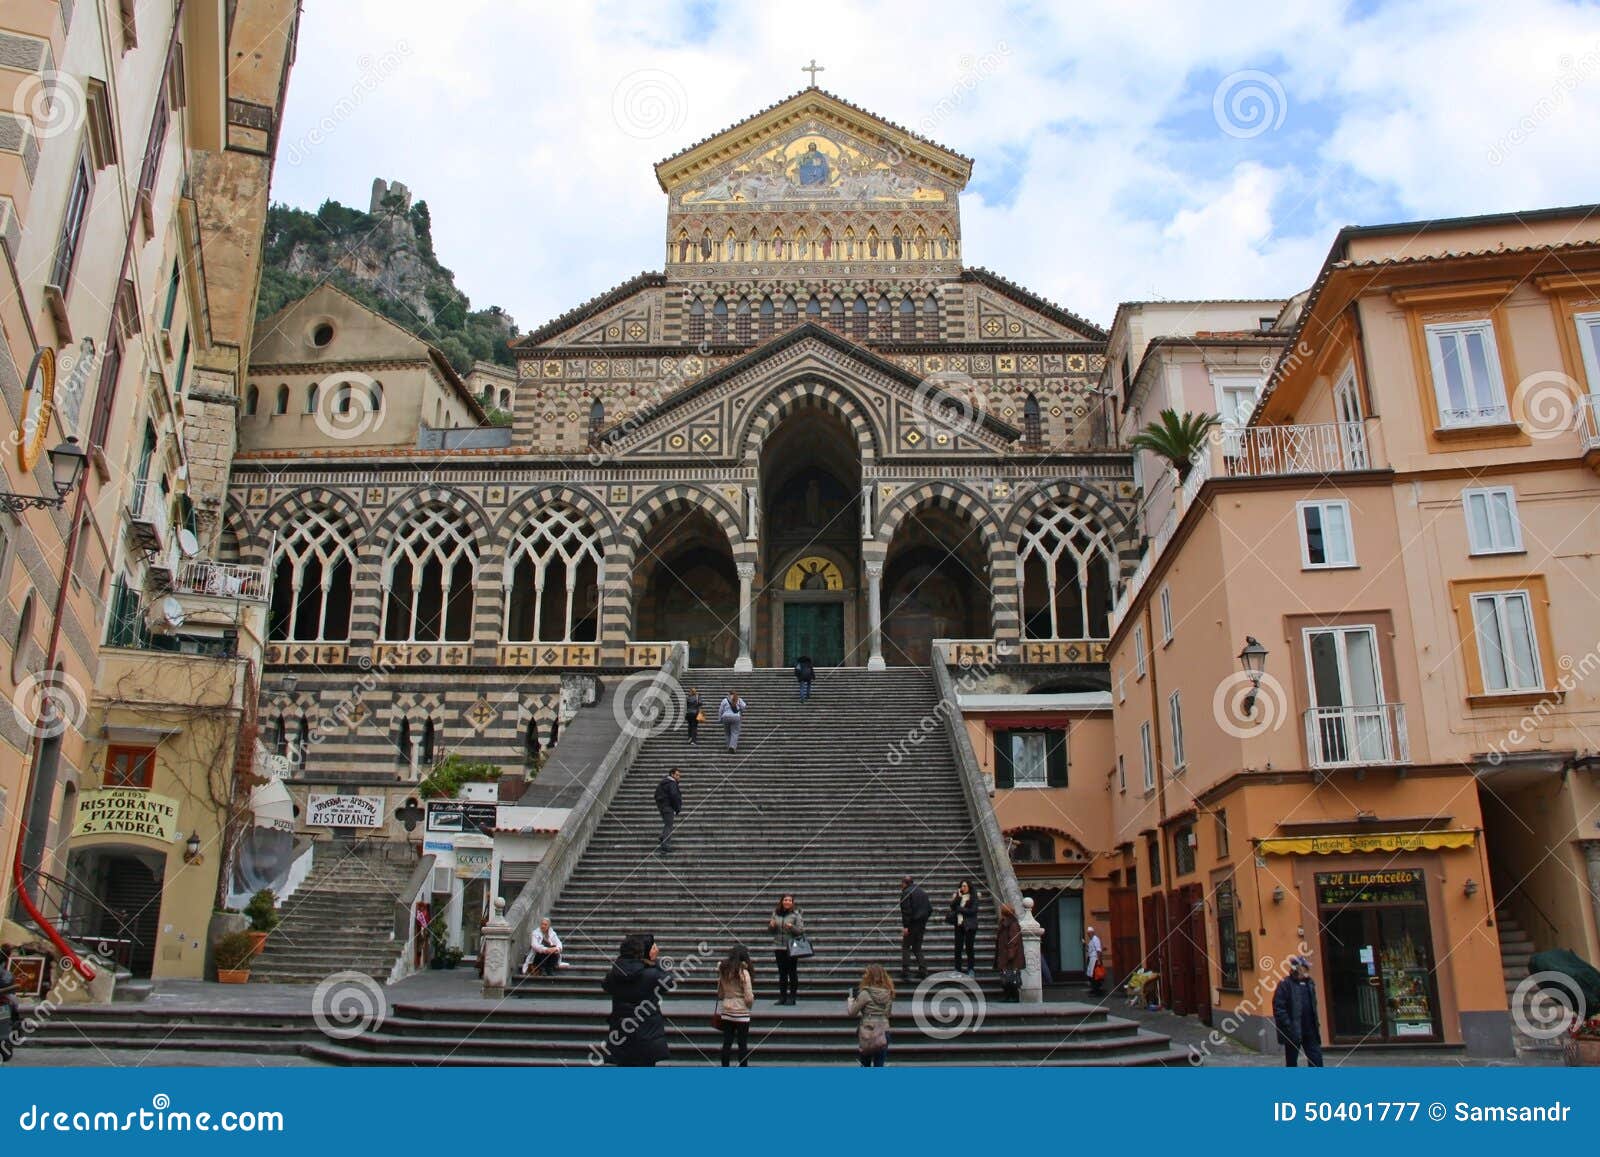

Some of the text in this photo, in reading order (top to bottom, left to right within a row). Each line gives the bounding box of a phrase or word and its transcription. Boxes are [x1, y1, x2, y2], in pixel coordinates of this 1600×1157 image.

[80, 798, 174, 817] RISTORANTE
[91, 809, 160, 825] PIZZERIA
[312, 813, 376, 826] RISTORANTE
[82, 820, 165, 838] S. ANDREA
[1349, 872, 1413, 884] Limoncello
